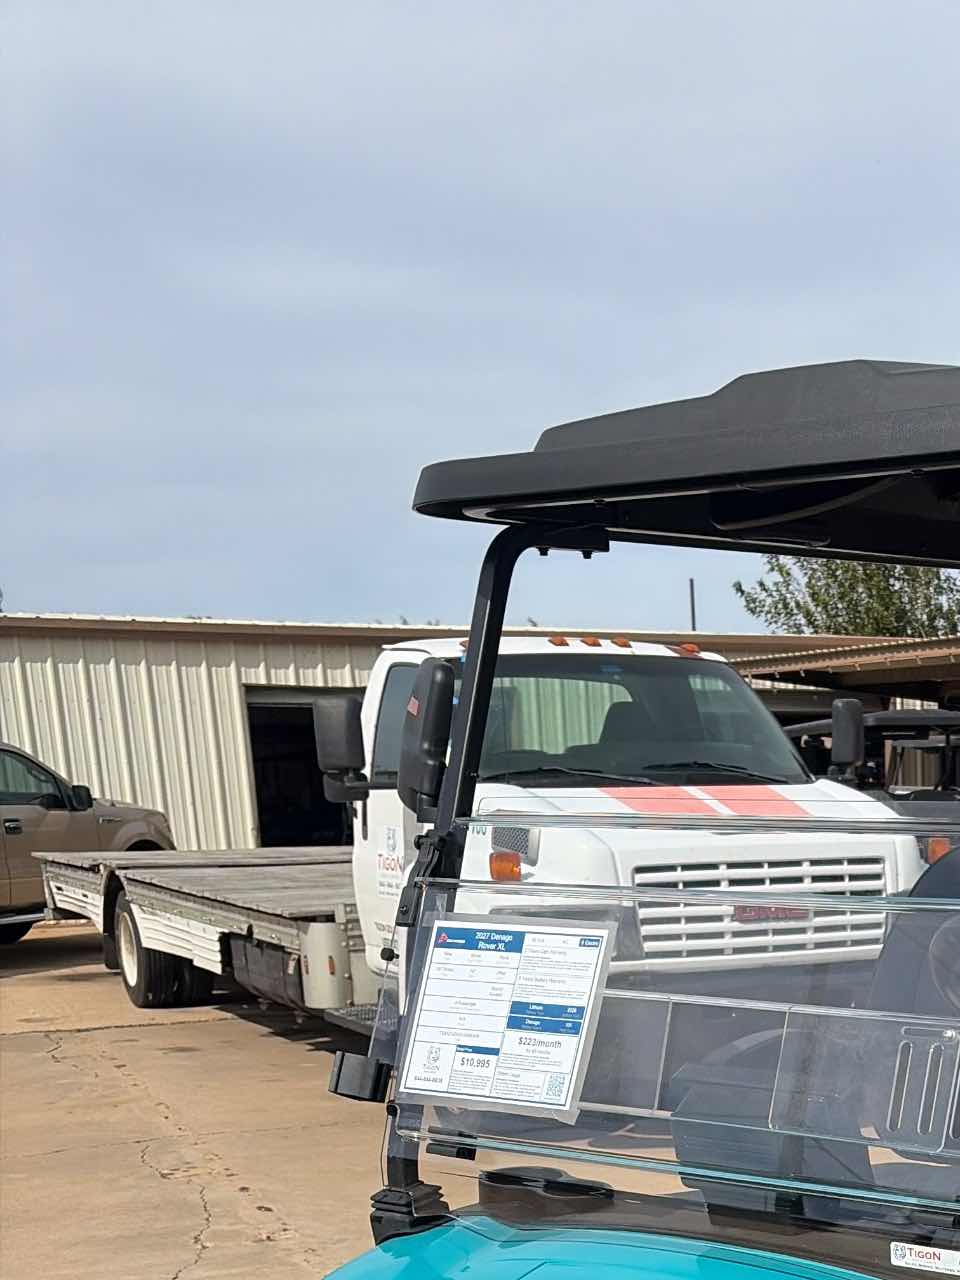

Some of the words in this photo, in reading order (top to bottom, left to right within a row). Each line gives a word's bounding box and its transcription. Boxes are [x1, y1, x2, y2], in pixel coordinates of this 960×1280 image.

[490, 932, 513, 942] Denago
[478, 941, 496, 949] Rover
[498, 942, 506, 950] XL
[906, 1247, 942, 1262] TIGON
